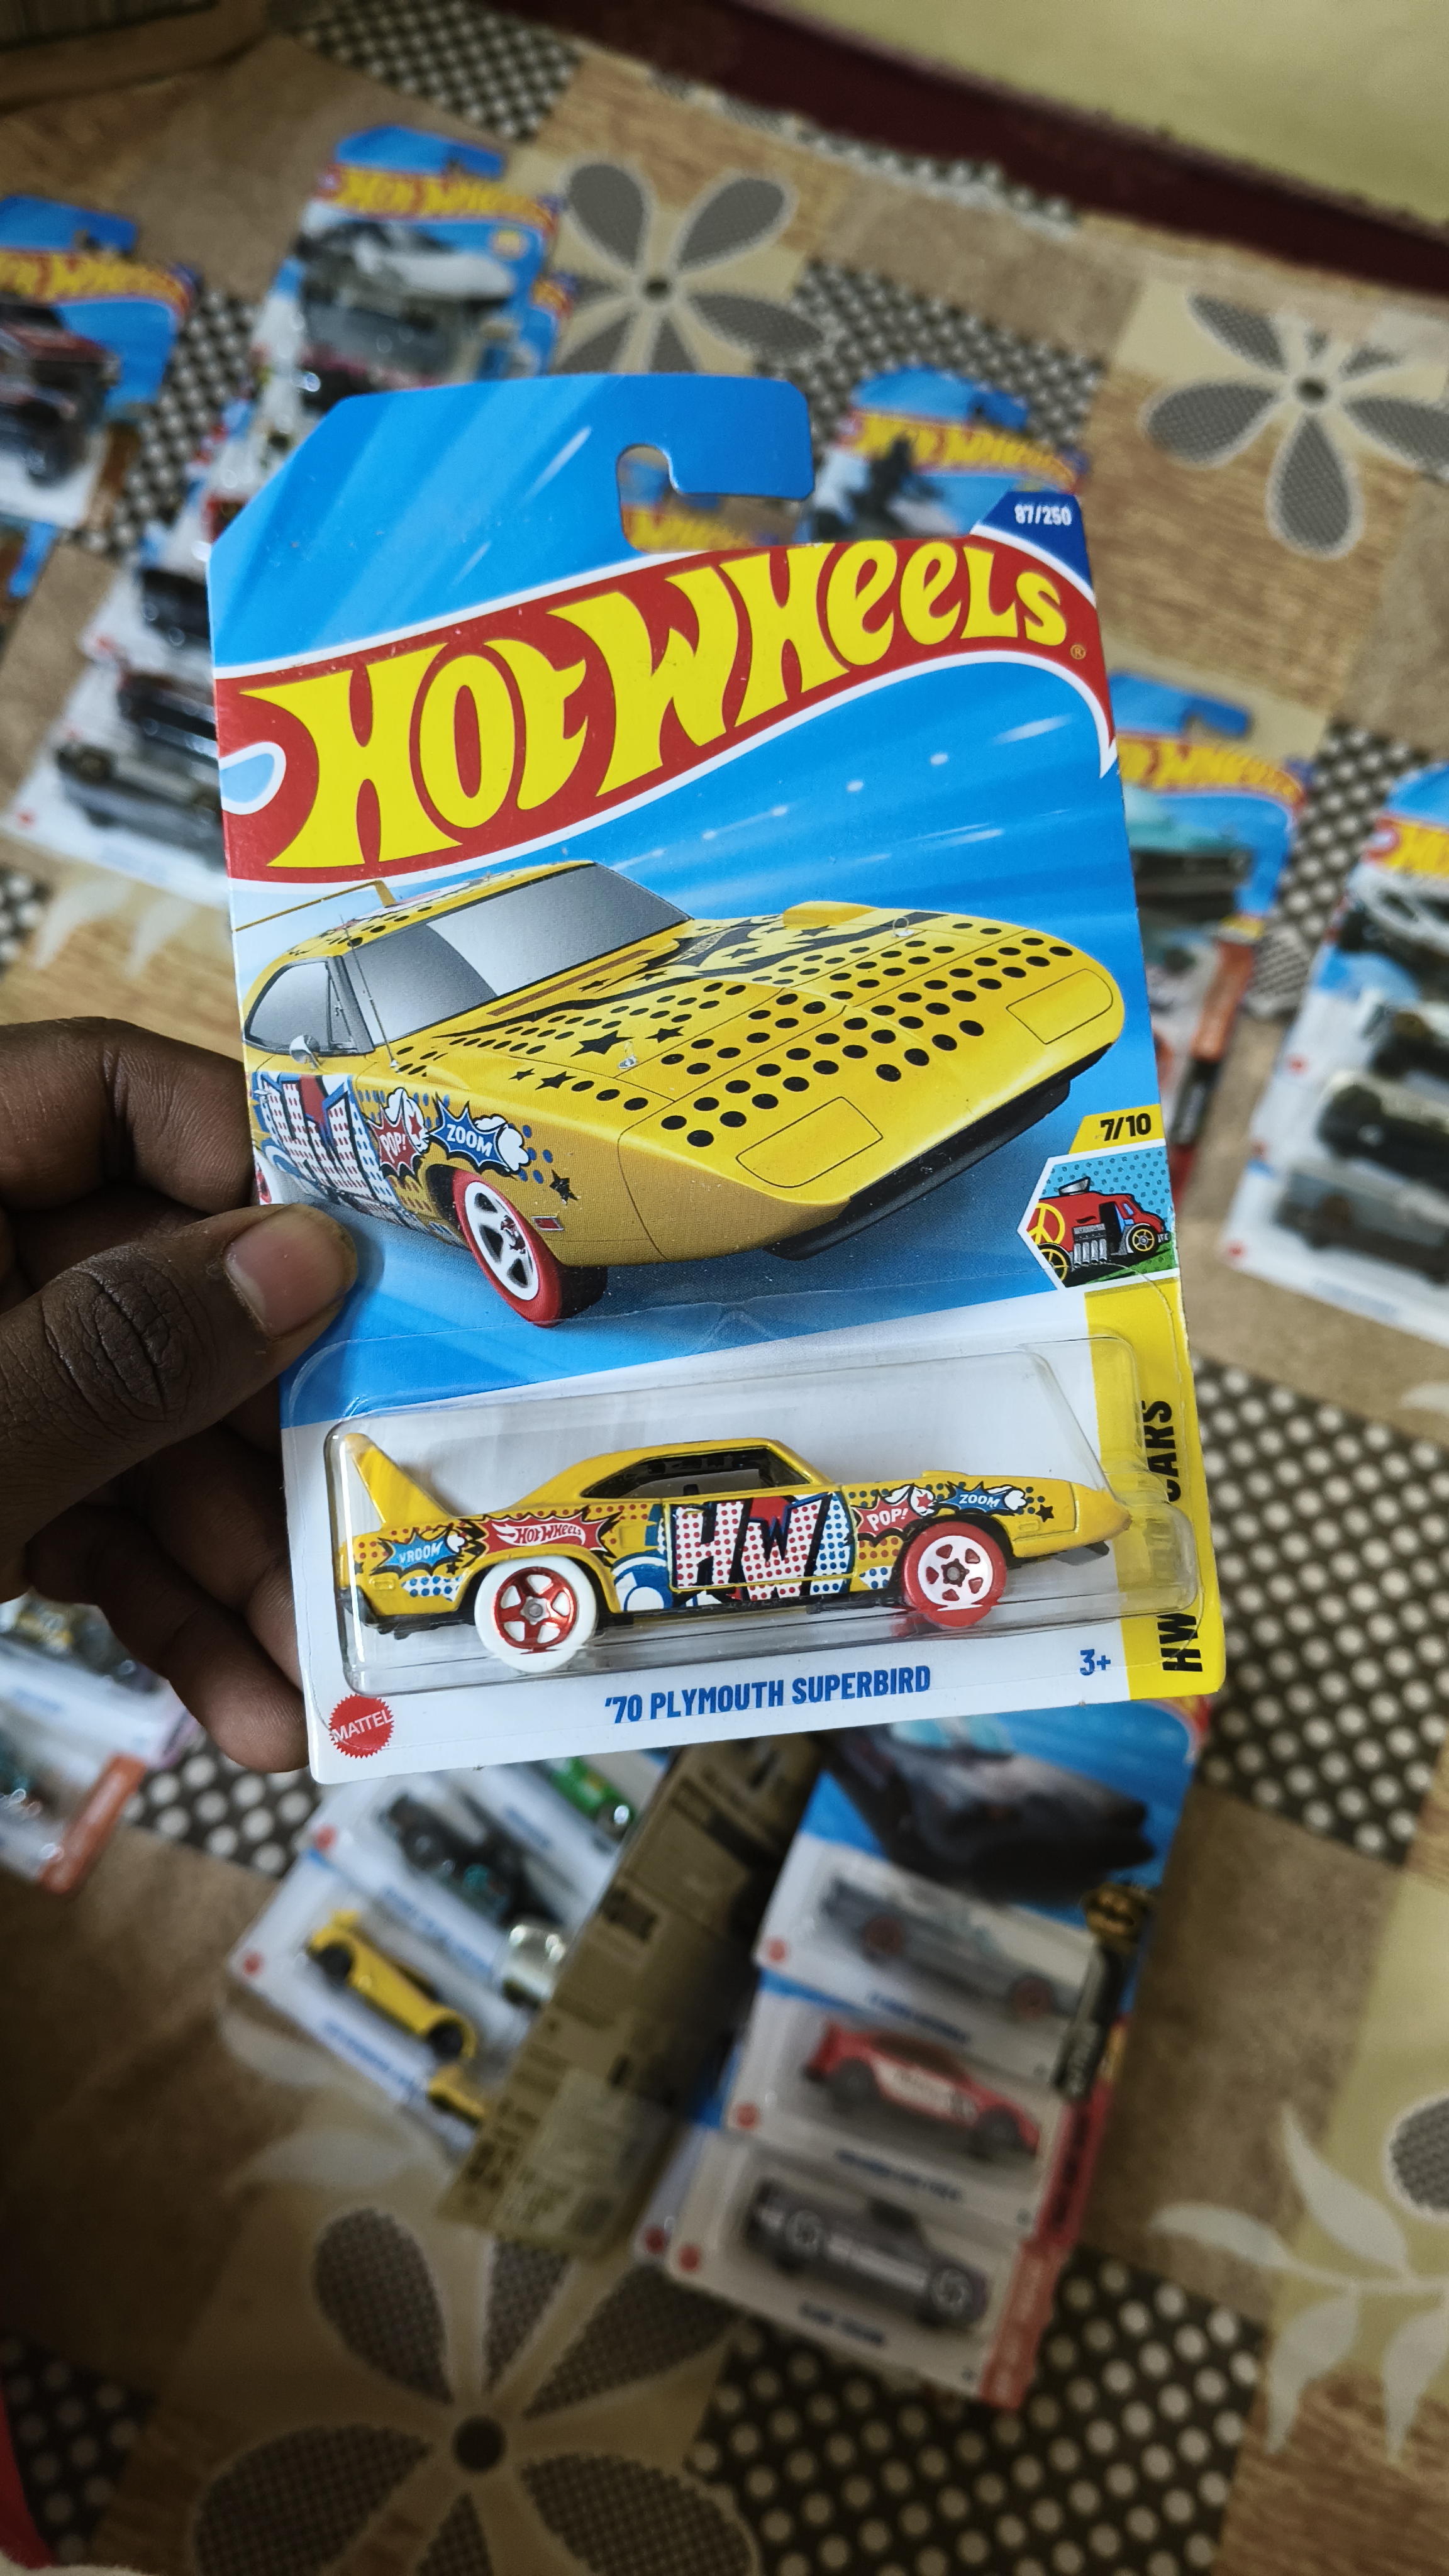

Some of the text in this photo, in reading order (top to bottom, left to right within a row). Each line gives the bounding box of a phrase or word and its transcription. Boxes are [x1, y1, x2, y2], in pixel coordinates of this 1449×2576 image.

[1014, 503, 1072, 526] 87/250
[446, 1123, 493, 1157] ZOOM
[1100, 1113, 1152, 1141] 7/10
[379, 1131, 407, 1163] POP!
[1141, 1400, 1182, 1502] CARS
[959, 1494, 1001, 1507] ZOOM
[866, 1507, 909, 1531] POP!
[399, 1541, 444, 1563] VROOM
[1157, 1612, 1203, 1672] HW
[1080, 1648, 1111, 1676] 3+
[604, 1665, 931, 1723] '70 PLYMOUTH SUPERBIRD
[331, 1709, 394, 1742] MATTEL
